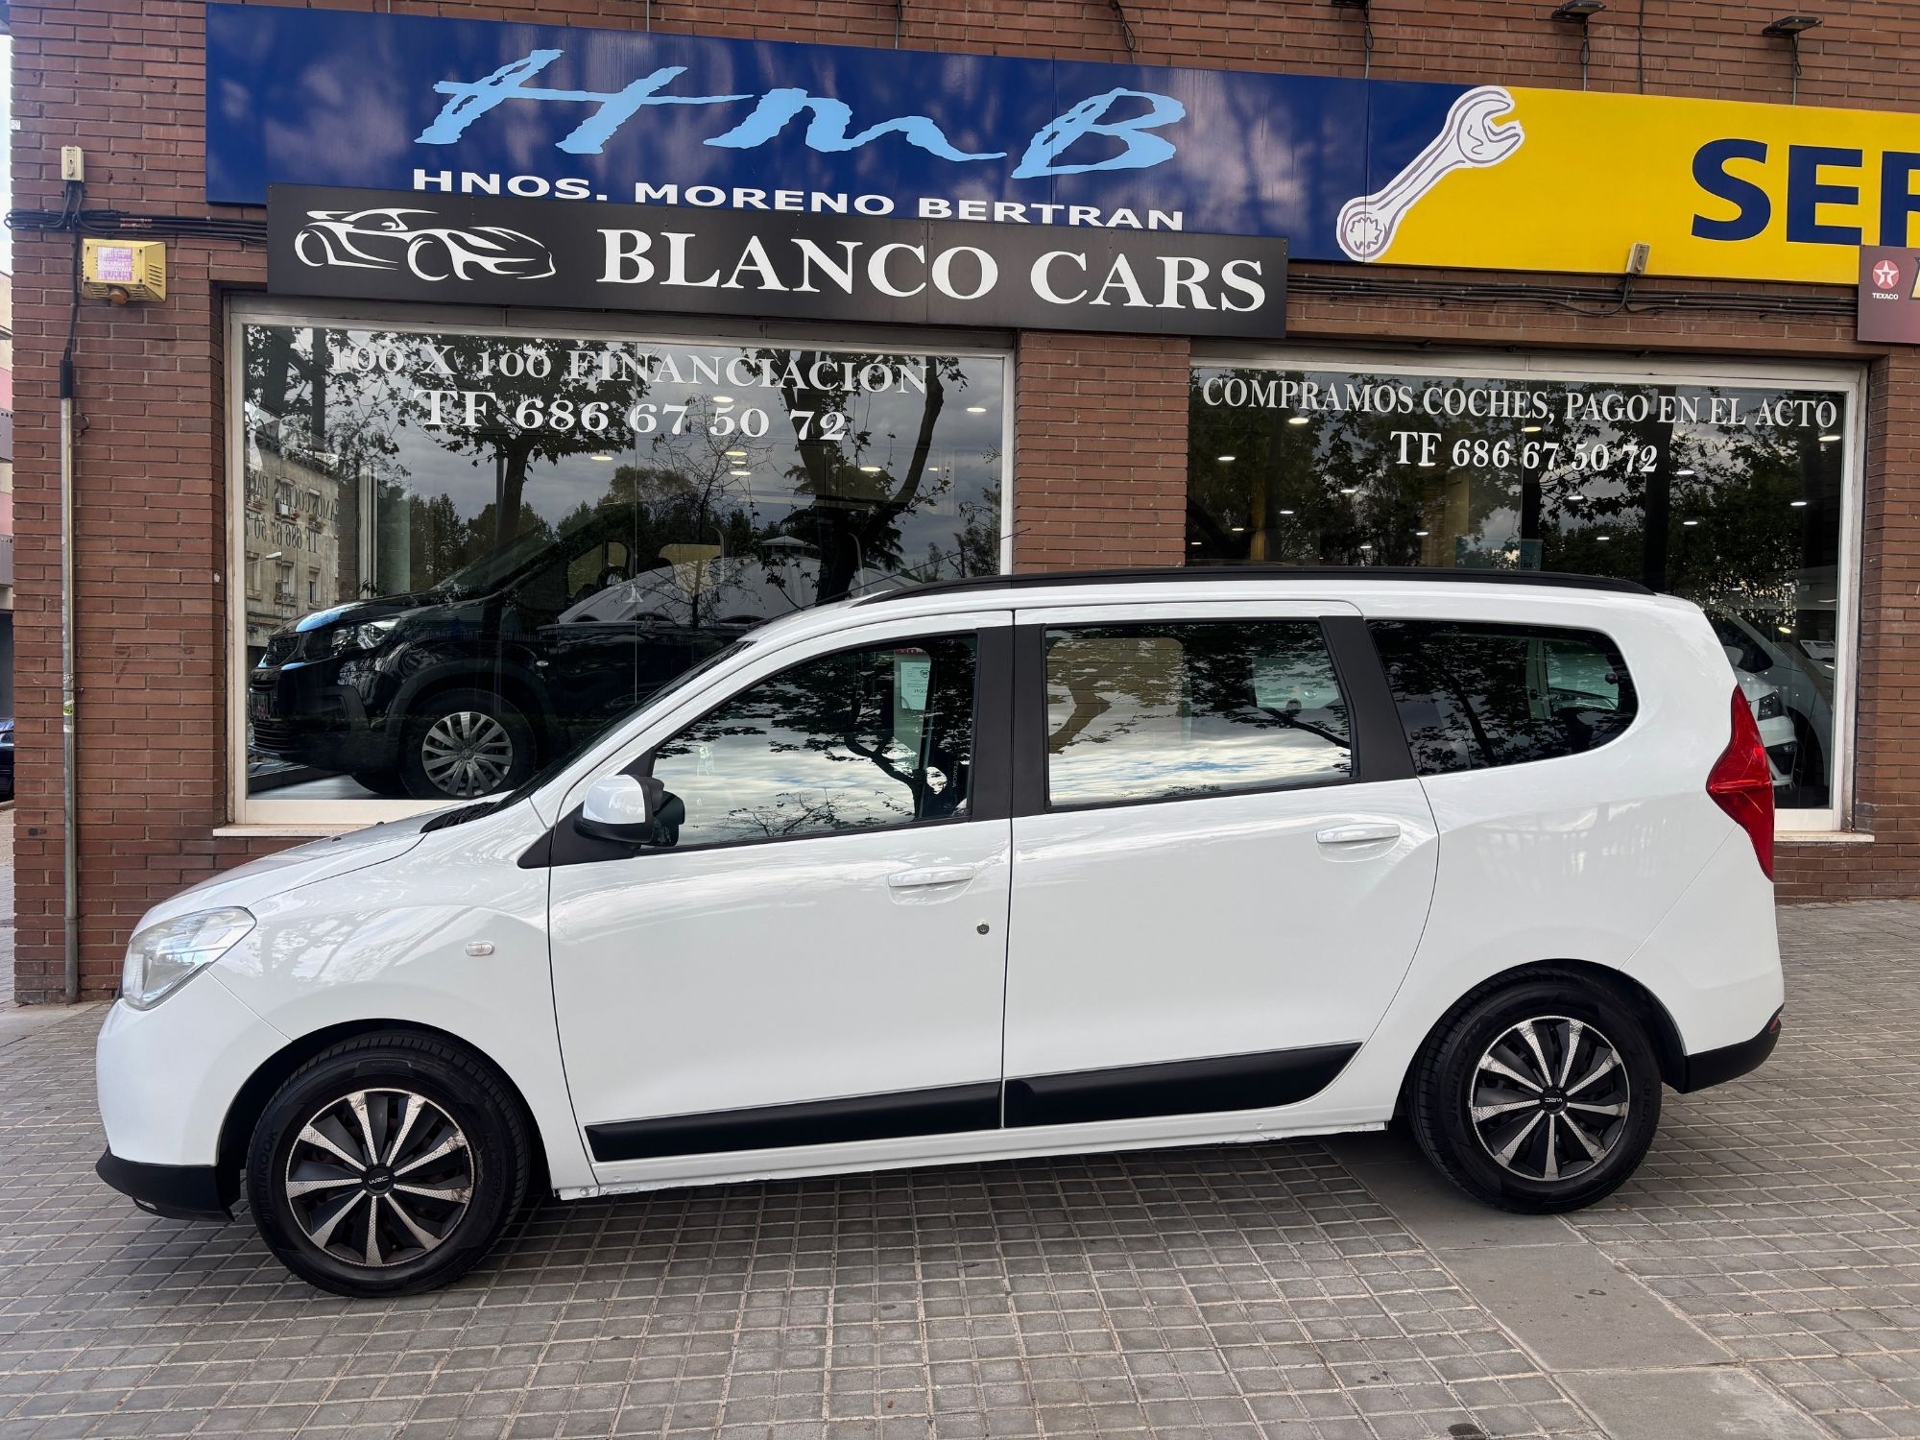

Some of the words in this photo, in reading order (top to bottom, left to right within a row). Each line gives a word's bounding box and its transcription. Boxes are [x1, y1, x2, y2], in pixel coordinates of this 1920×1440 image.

[413, 168, 607, 200] HNOS.
[635, 182, 894, 216] MORENO
[919, 198, 1183, 231] BERTRAN
[596, 229, 998, 299] BLANCO
[1030, 251, 1266, 312] CARS
[1872, 292, 1899, 300] TEXACO
[328, 345, 404, 373] 100
[420, 345, 458, 375] X
[478, 350, 551, 378] 100
[566, 350, 930, 395] FINANCIACIÓN
[413, 389, 496, 427] TF
[516, 399, 609, 431] 686
[629, 403, 689, 435] 67
[709, 404, 770, 437] 50
[789, 409, 847, 441] 72
[1202, 377, 1414, 414] COMPRAMOS
[1423, 387, 1555, 424] COCHES,
[1565, 392, 1649, 423] PAGO
[1657, 395, 1701, 424] EN
[1709, 397, 1747, 426] EL
[1754, 399, 1837, 428] ACTO
[1390, 431, 1442, 466] TF
[1452, 439, 1510, 468] 686
[1523, 441, 1560, 470] 67
[1571, 442, 1609, 471] 50
[1621, 445, 1657, 473] 72
[368, 1175, 389, 1184] WRC
